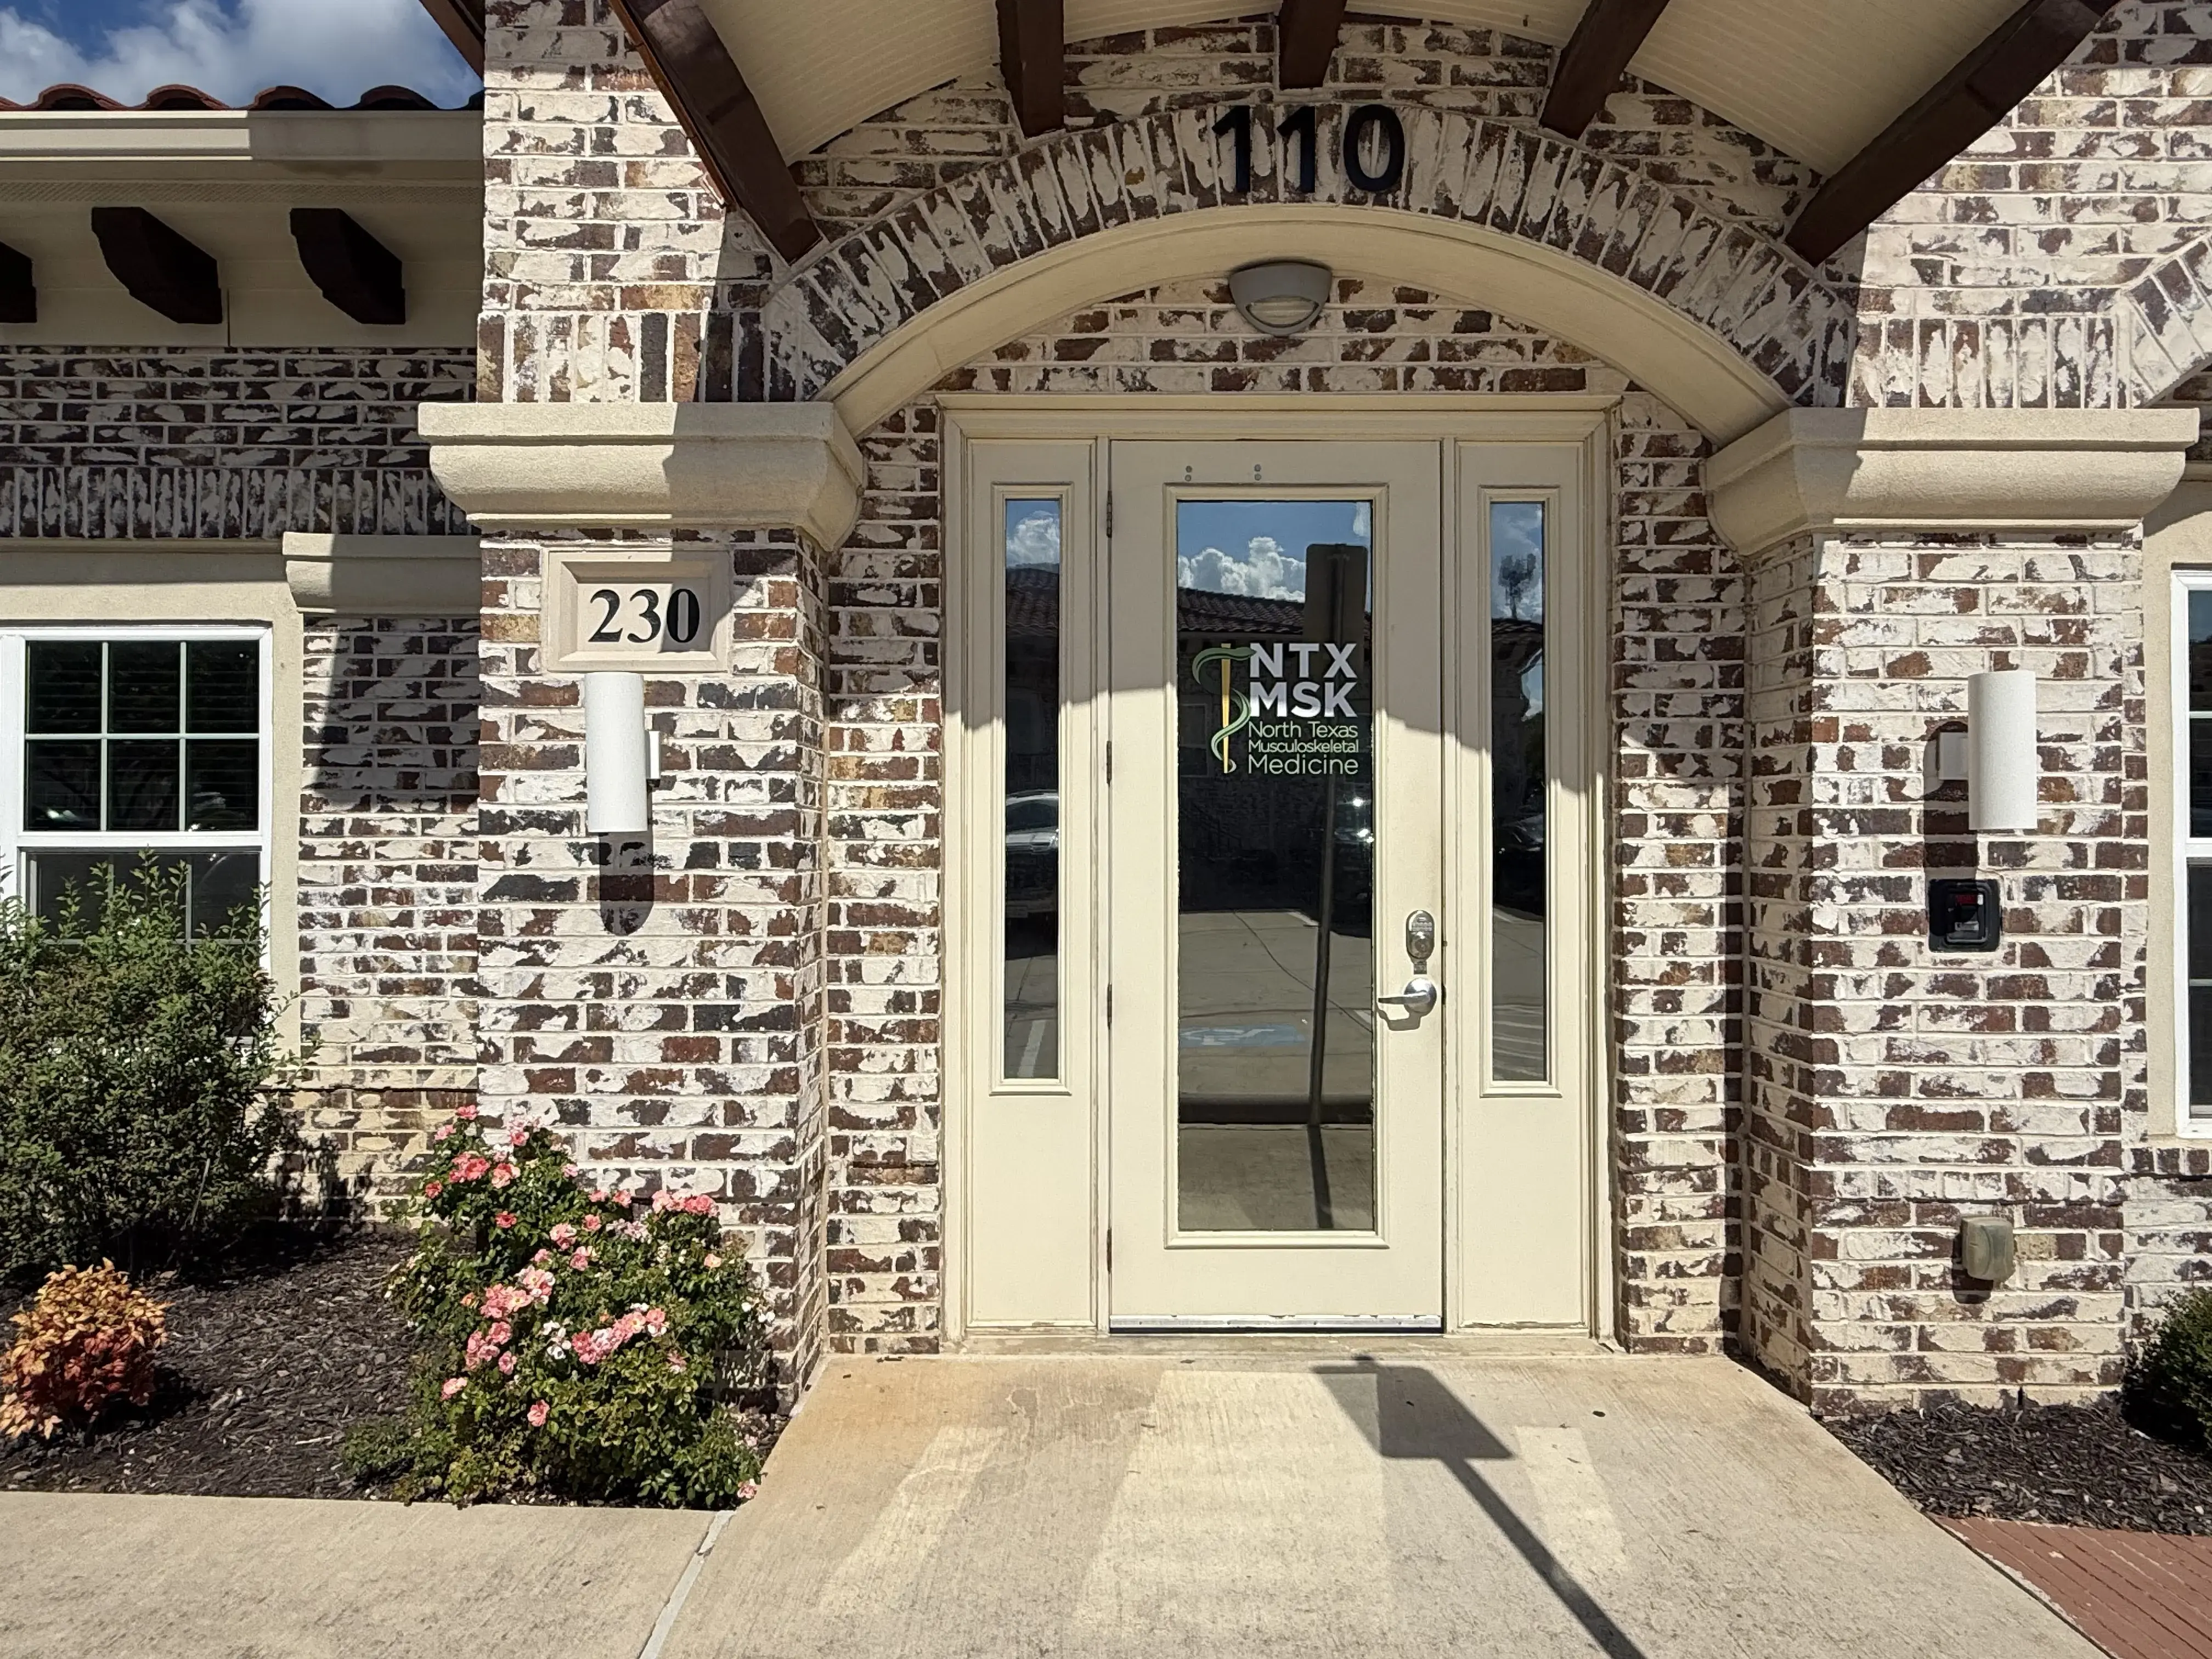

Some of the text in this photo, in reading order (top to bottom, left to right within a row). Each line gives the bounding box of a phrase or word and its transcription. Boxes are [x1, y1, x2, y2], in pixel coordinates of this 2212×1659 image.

[1212, 104, 1405, 193] 110
[588, 589, 700, 643] 230
[1250, 643, 1358, 678] NTX
[1250, 681, 1358, 718] MSK
[1248, 721, 1358, 738] North Texas
[1248, 739, 1359, 753] Musculoskeletal
[1248, 754, 1359, 775] Medicine
